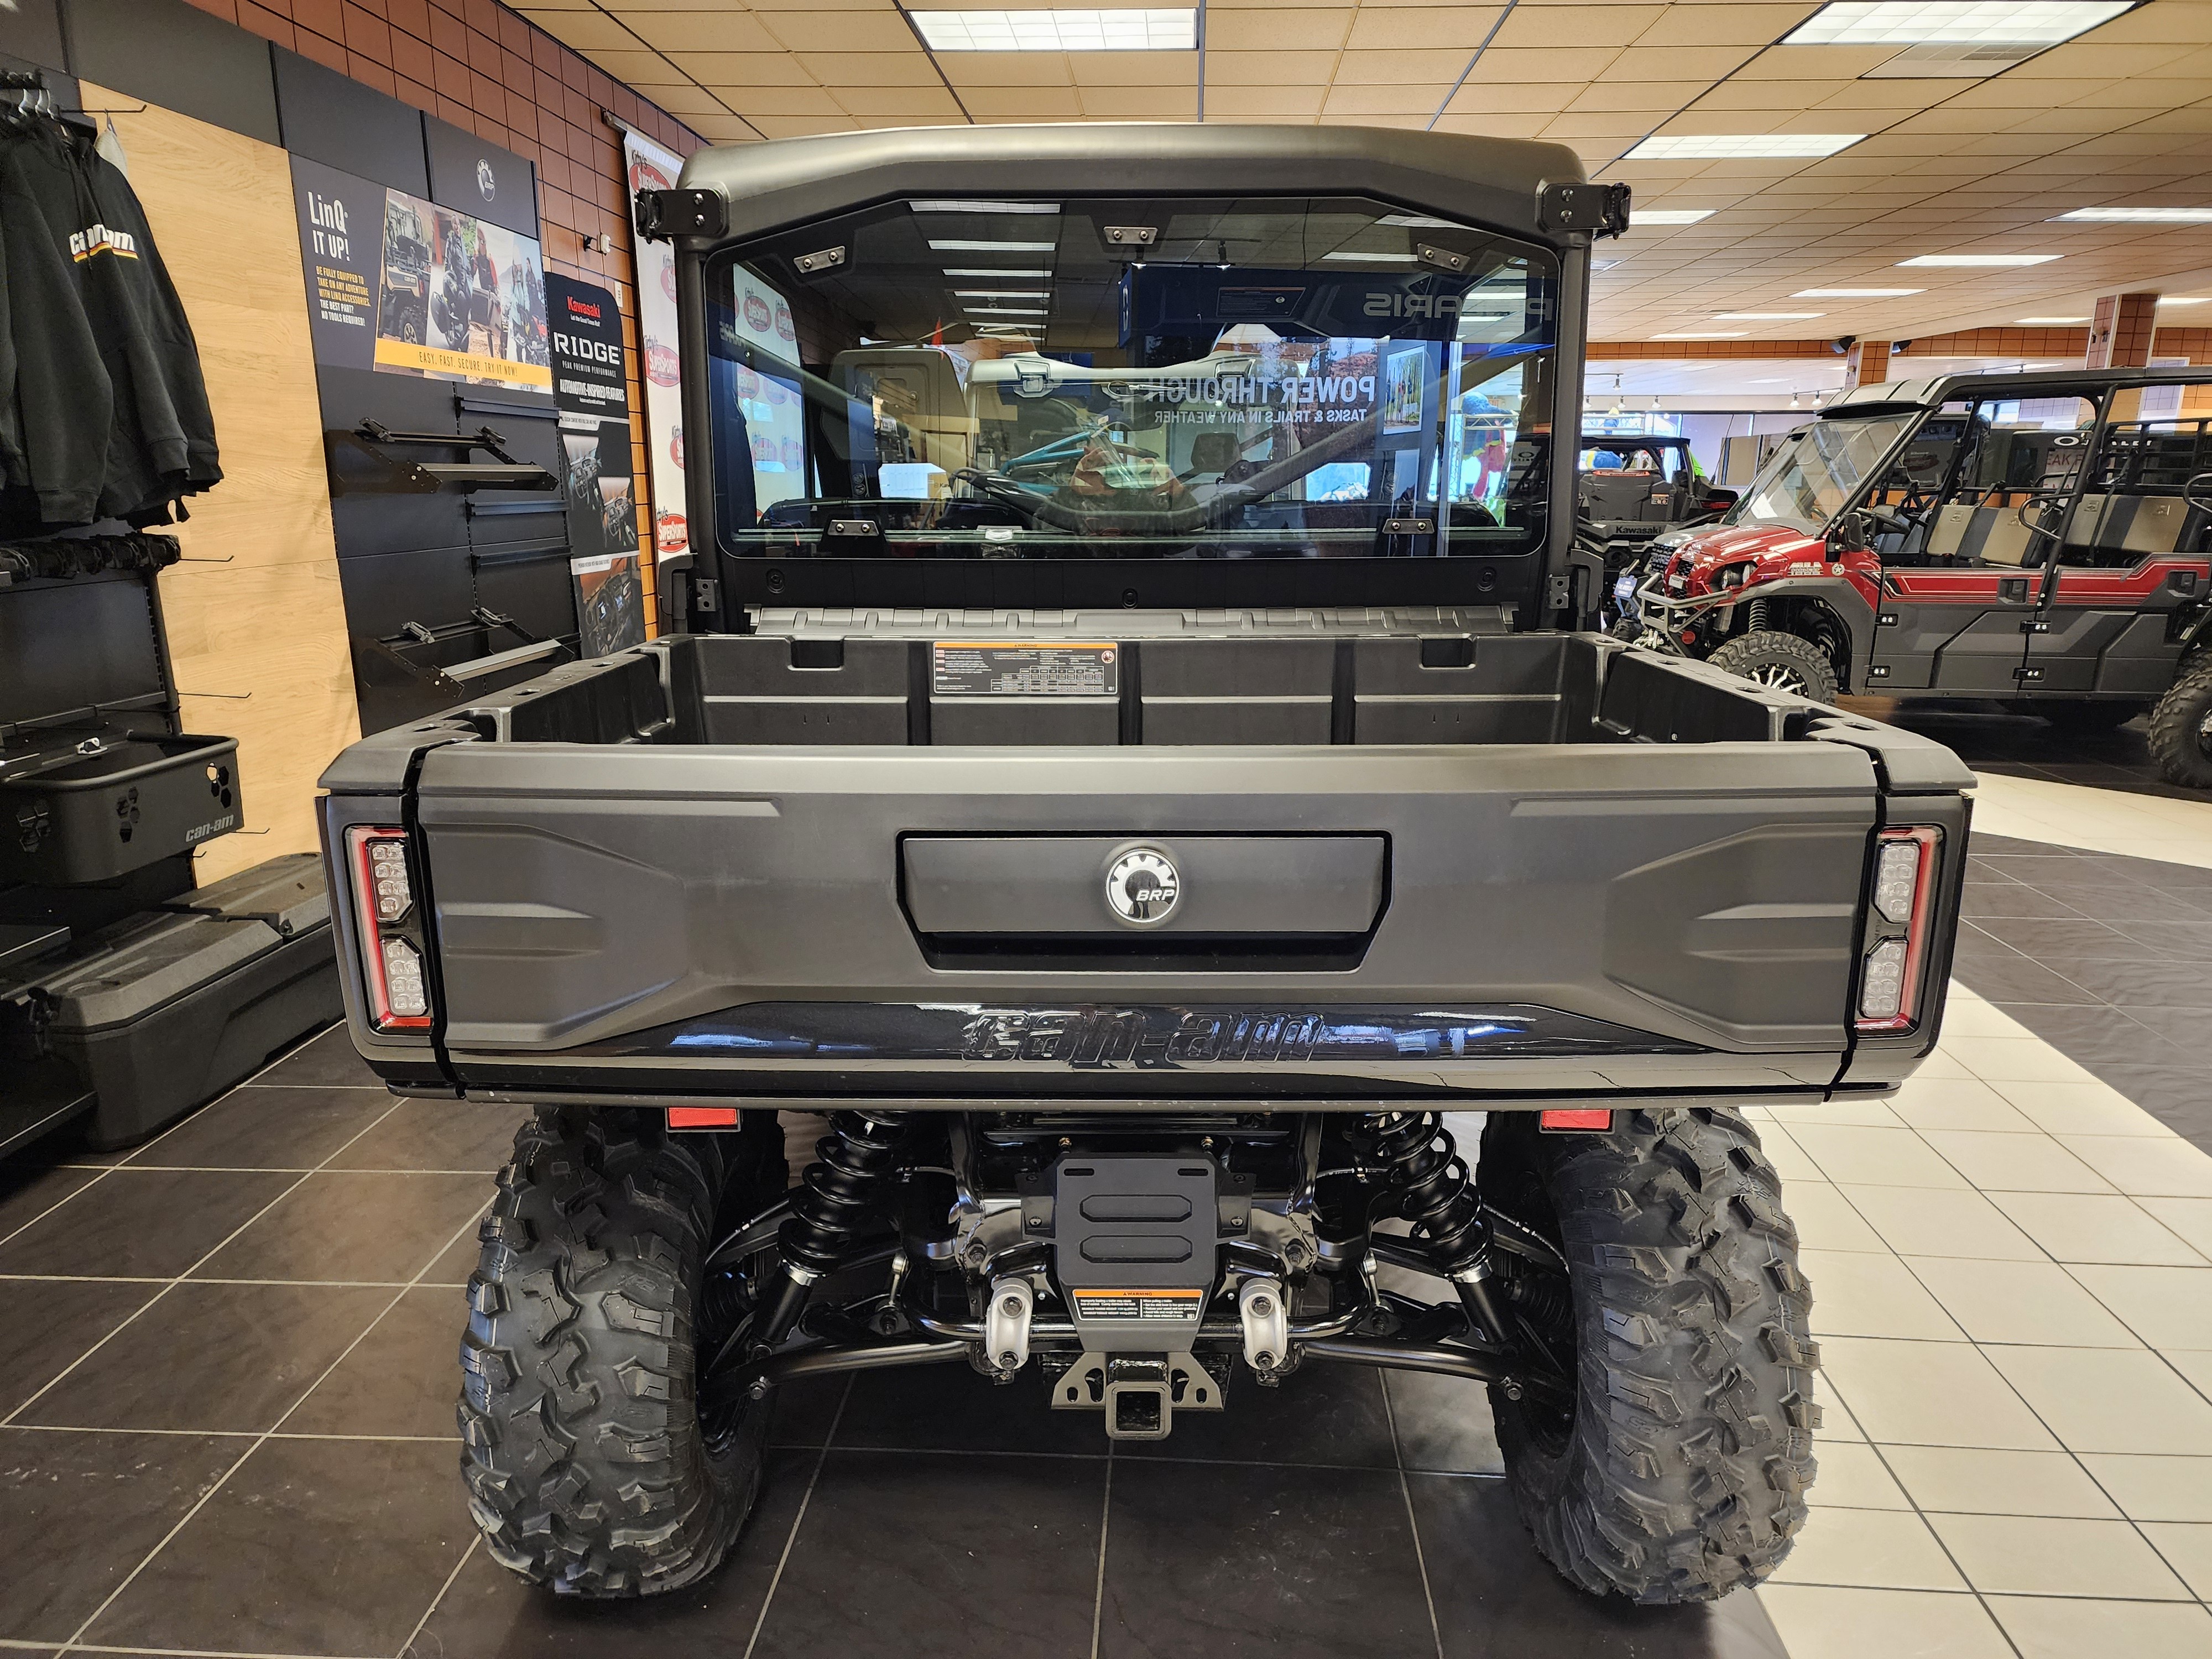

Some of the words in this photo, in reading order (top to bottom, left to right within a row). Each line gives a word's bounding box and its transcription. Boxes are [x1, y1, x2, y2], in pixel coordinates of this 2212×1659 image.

[312, 229, 324, 255] IT
[328, 233, 350, 262] UP!
[316, 265, 323, 276] BE
[323, 267, 336, 278] FULLY
[336, 270, 358, 283] EQUIPPED
[358, 275, 364, 285] TO
[317, 276, 329, 288] TAKE
[329, 279, 336, 289] ON
[336, 281, 345, 291] ANY
[345, 283, 369, 296] ADVENTURE
[318, 288, 331, 299] WITH
[320, 299, 329, 309] THE
[329, 301, 340, 311] BEST
[341, 303, 354, 314] PART?
[567, 295, 601, 319] Kawasaki
[321, 310, 328, 320] NO
[328, 311, 342, 322] TOOLS
[342, 314, 366, 326] REQUIRED!
[554, 331, 620, 365] RIDGE
[419, 351, 437, 364] EASY.
[440, 354, 455, 367] FAST.
[458, 358, 482, 372] SECURE.
[484, 362, 494, 373] TRY
[497, 364, 502, 374] IT
[504, 367, 518, 377] NOW!
[562, 359, 572, 369] PEAK
[573, 362, 591, 373] PREMIUM
[591, 366, 617, 378] PERFORMANCE
[560, 378, 606, 399] AUTOMOTIVE-INSPIRED
[606, 386, 625, 402] FEATURES
[1615, 526, 1661, 534] Kawasaki
[186, 814, 234, 843] can-am
[1136, 889, 1175, 901] BRP
[962, 1010, 1326, 1064] can-am
